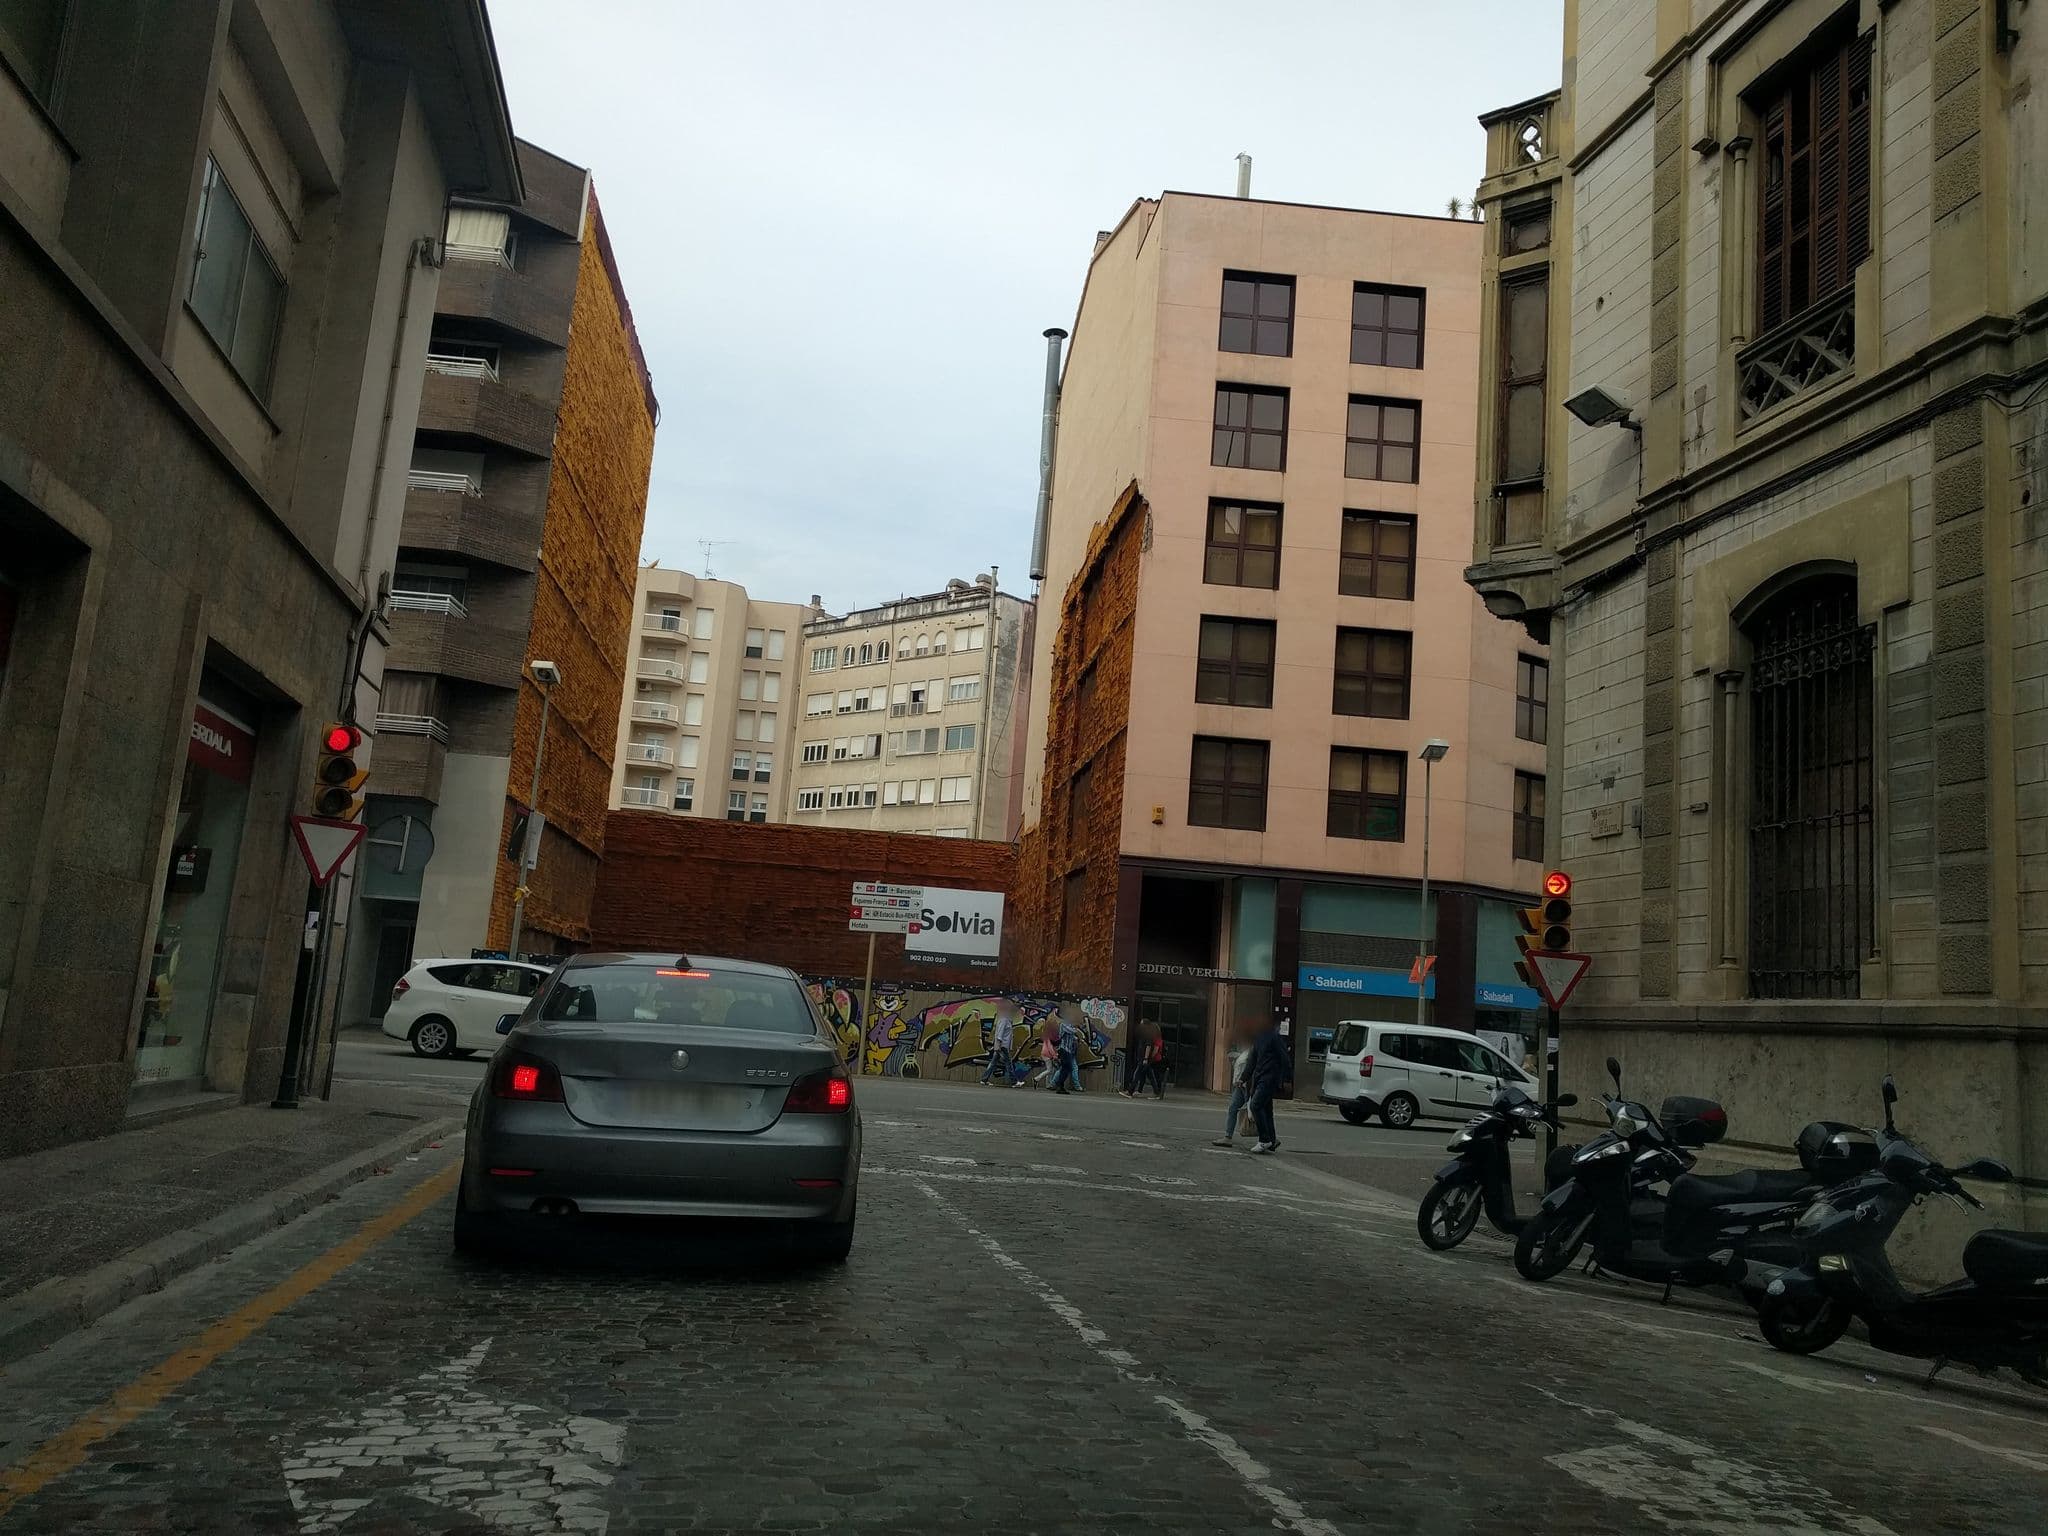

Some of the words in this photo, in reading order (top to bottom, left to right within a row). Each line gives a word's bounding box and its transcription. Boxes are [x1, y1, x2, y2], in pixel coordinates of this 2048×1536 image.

[896, 887, 921, 896] Barcelona
[851, 921, 868, 929] Hotels
[920, 908, 995, 936] Solvia
[1138, 963, 1183, 975] EDIFICI
[1315, 976, 1363, 990] Sabadell
[1483, 990, 1514, 1004] Sabadell
